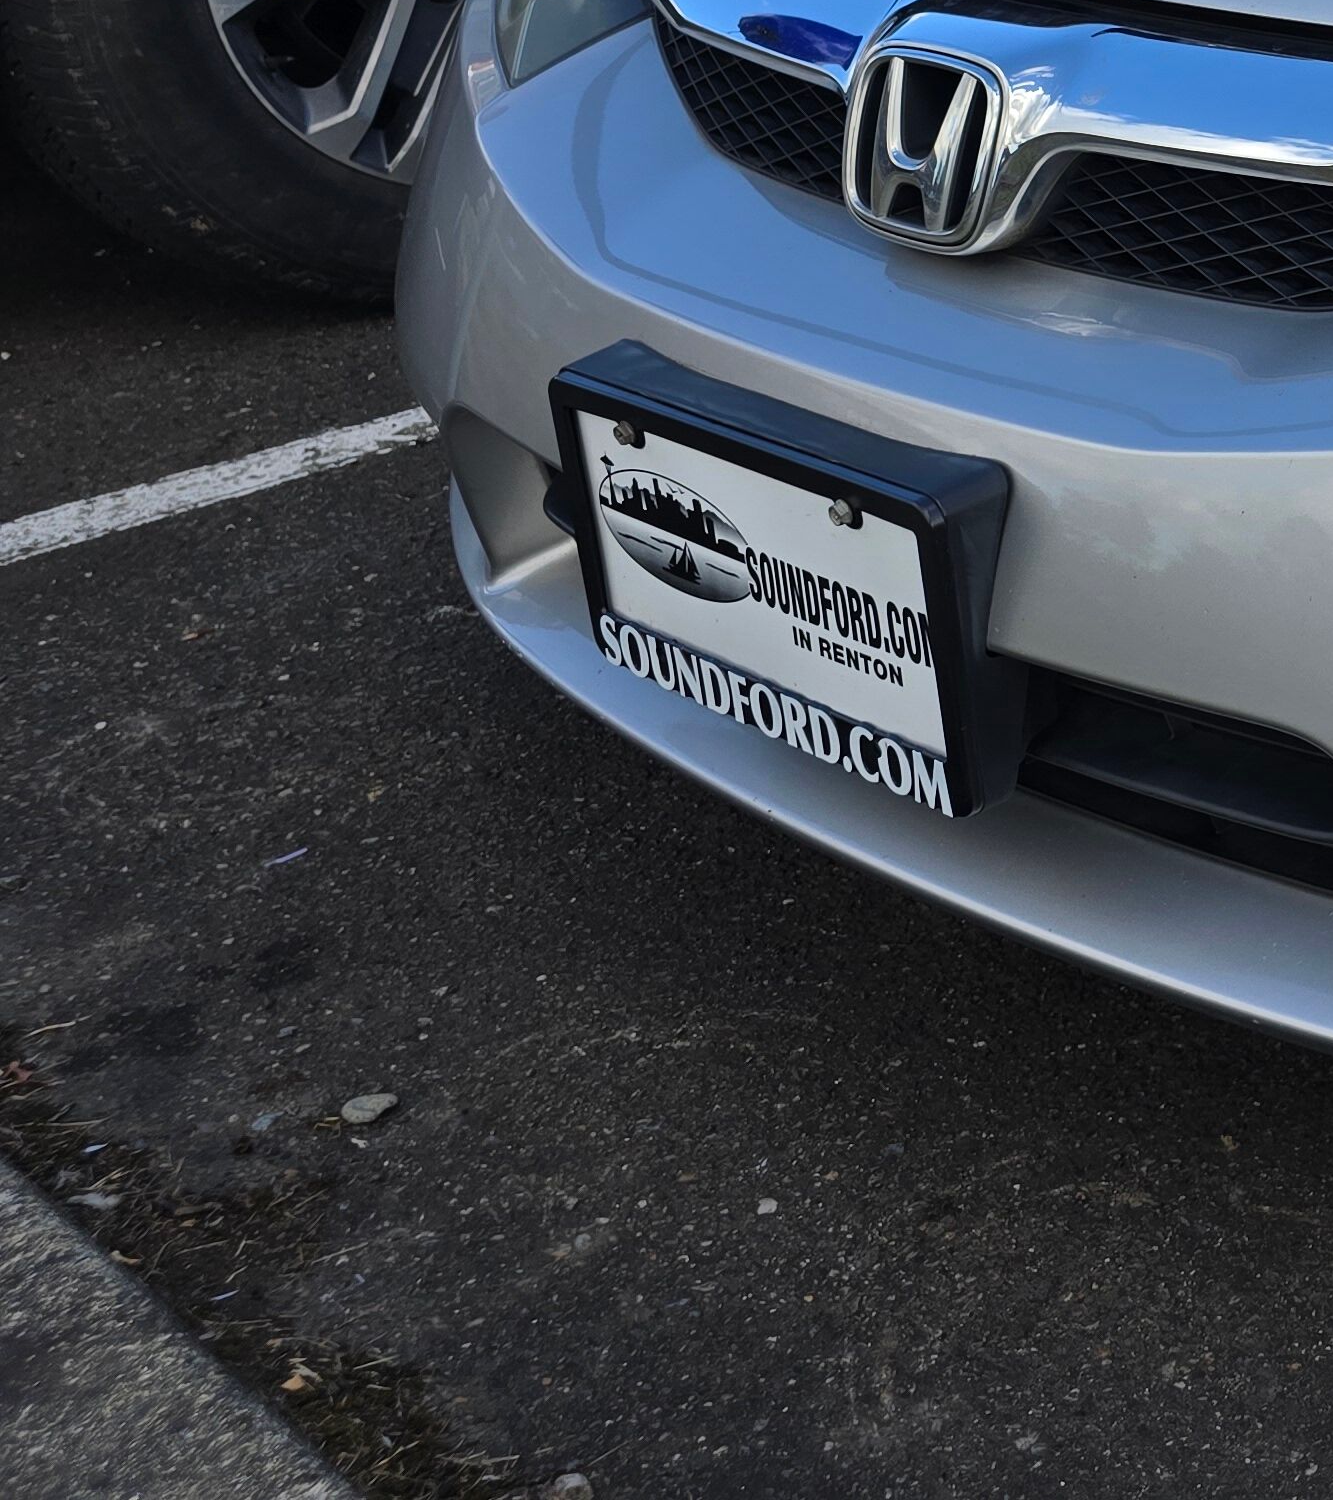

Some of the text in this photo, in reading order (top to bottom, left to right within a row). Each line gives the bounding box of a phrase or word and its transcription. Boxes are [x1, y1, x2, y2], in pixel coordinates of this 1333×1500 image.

[600, 614, 953, 818] SOUNDFORD.COM
[793, 625, 904, 687] IN RENTON
